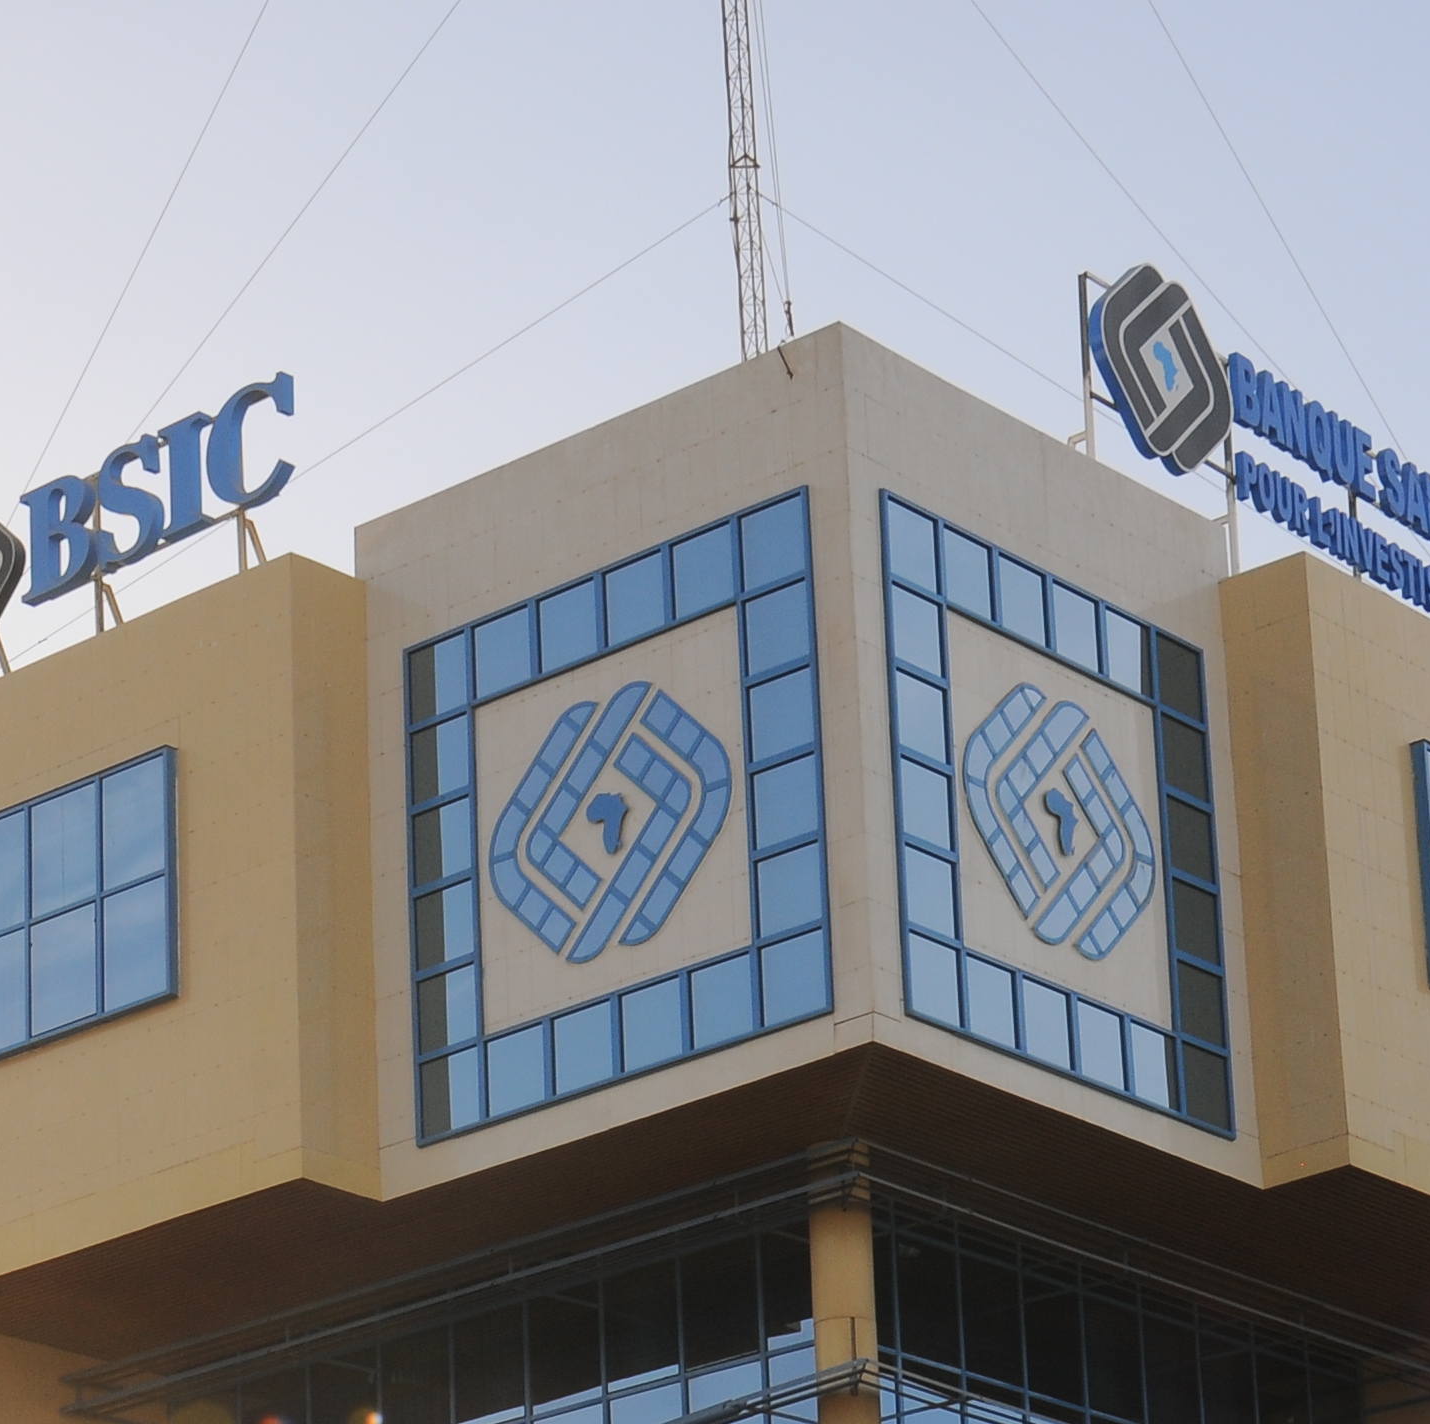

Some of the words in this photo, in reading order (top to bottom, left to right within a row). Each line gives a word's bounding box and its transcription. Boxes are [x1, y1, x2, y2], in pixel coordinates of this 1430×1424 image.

[20, 371, 295, 607] BSIC
[1228, 352, 1376, 504] BANQUE
[1235, 451, 1311, 537] POUR
